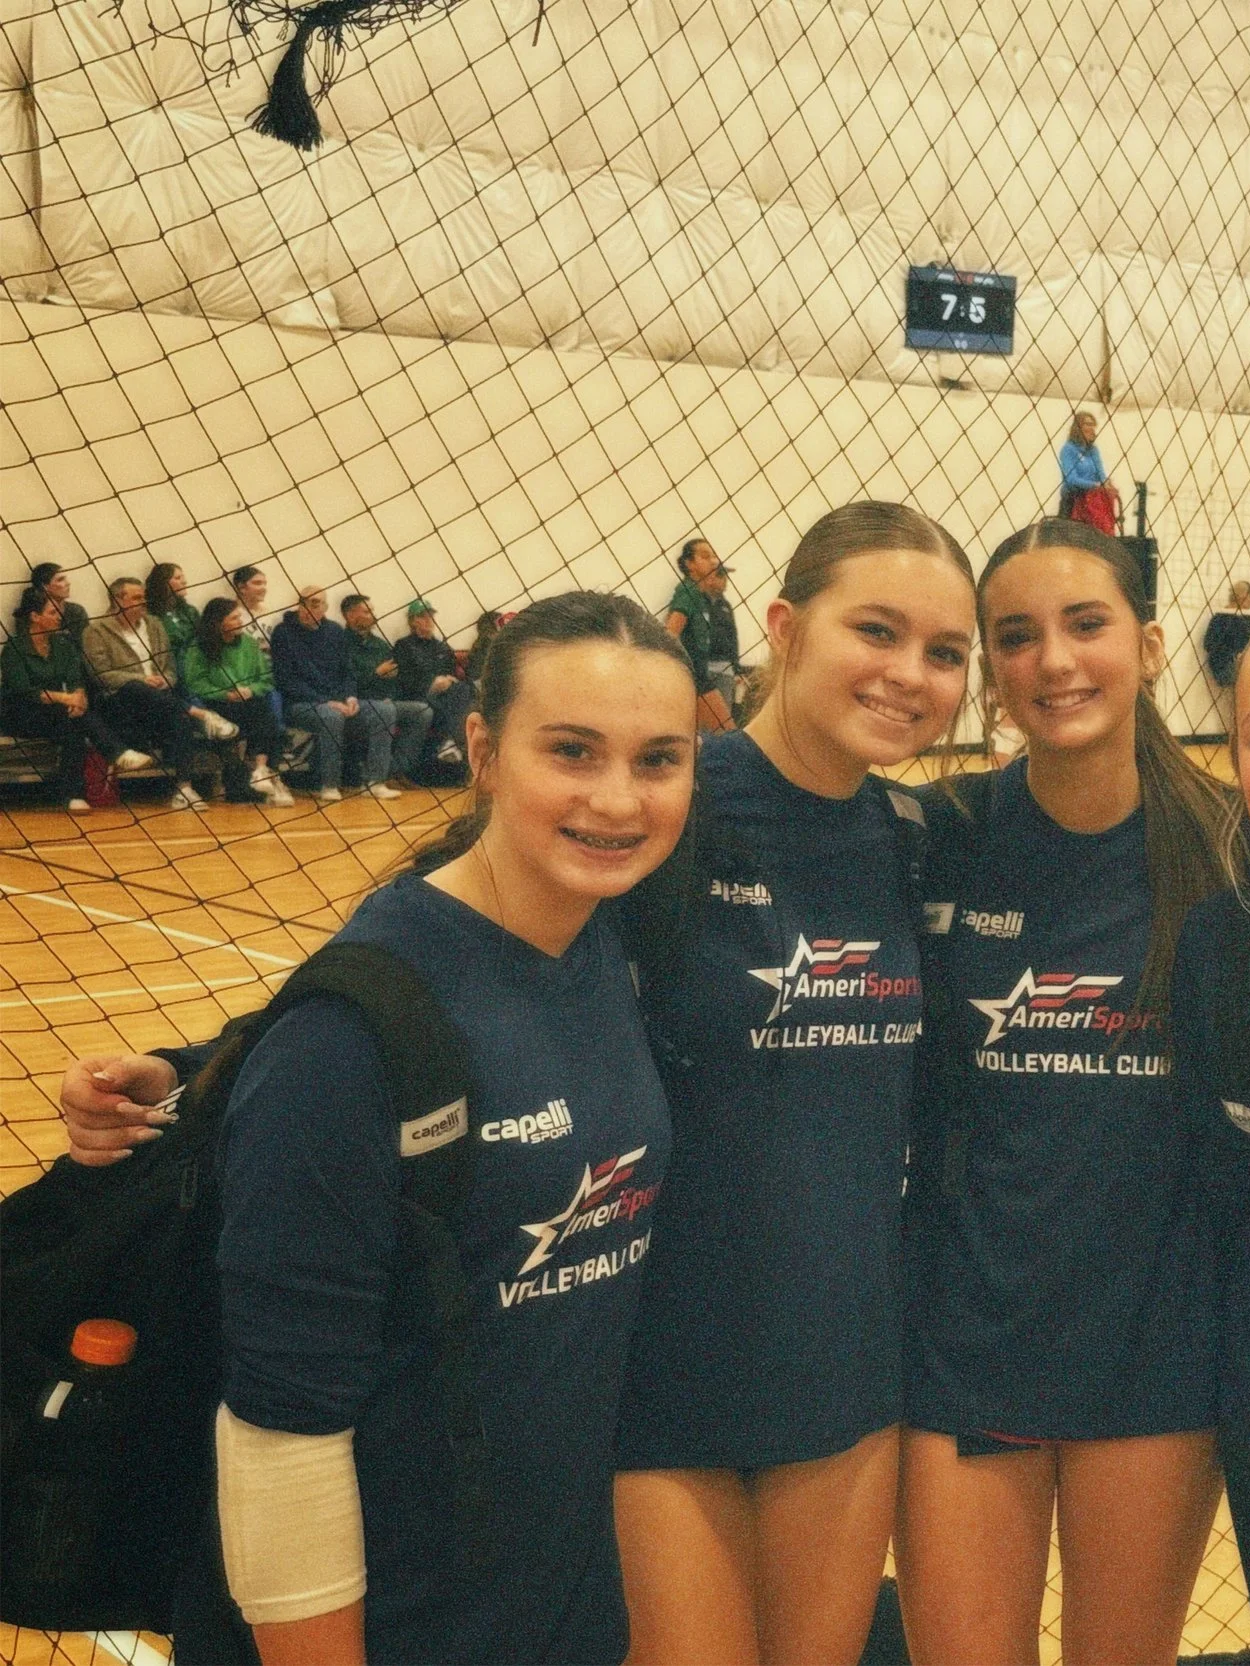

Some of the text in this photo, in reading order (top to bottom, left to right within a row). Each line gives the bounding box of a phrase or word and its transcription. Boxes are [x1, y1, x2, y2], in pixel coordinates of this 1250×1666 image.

[961, 910, 1025, 932] apelli
[750, 1024, 878, 1049] VOLLEYBALL
[976, 1050, 1111, 1075] VOLLEYBALL
[481, 1098, 572, 1144] capelli
[530, 1125, 574, 1145] SPORT
